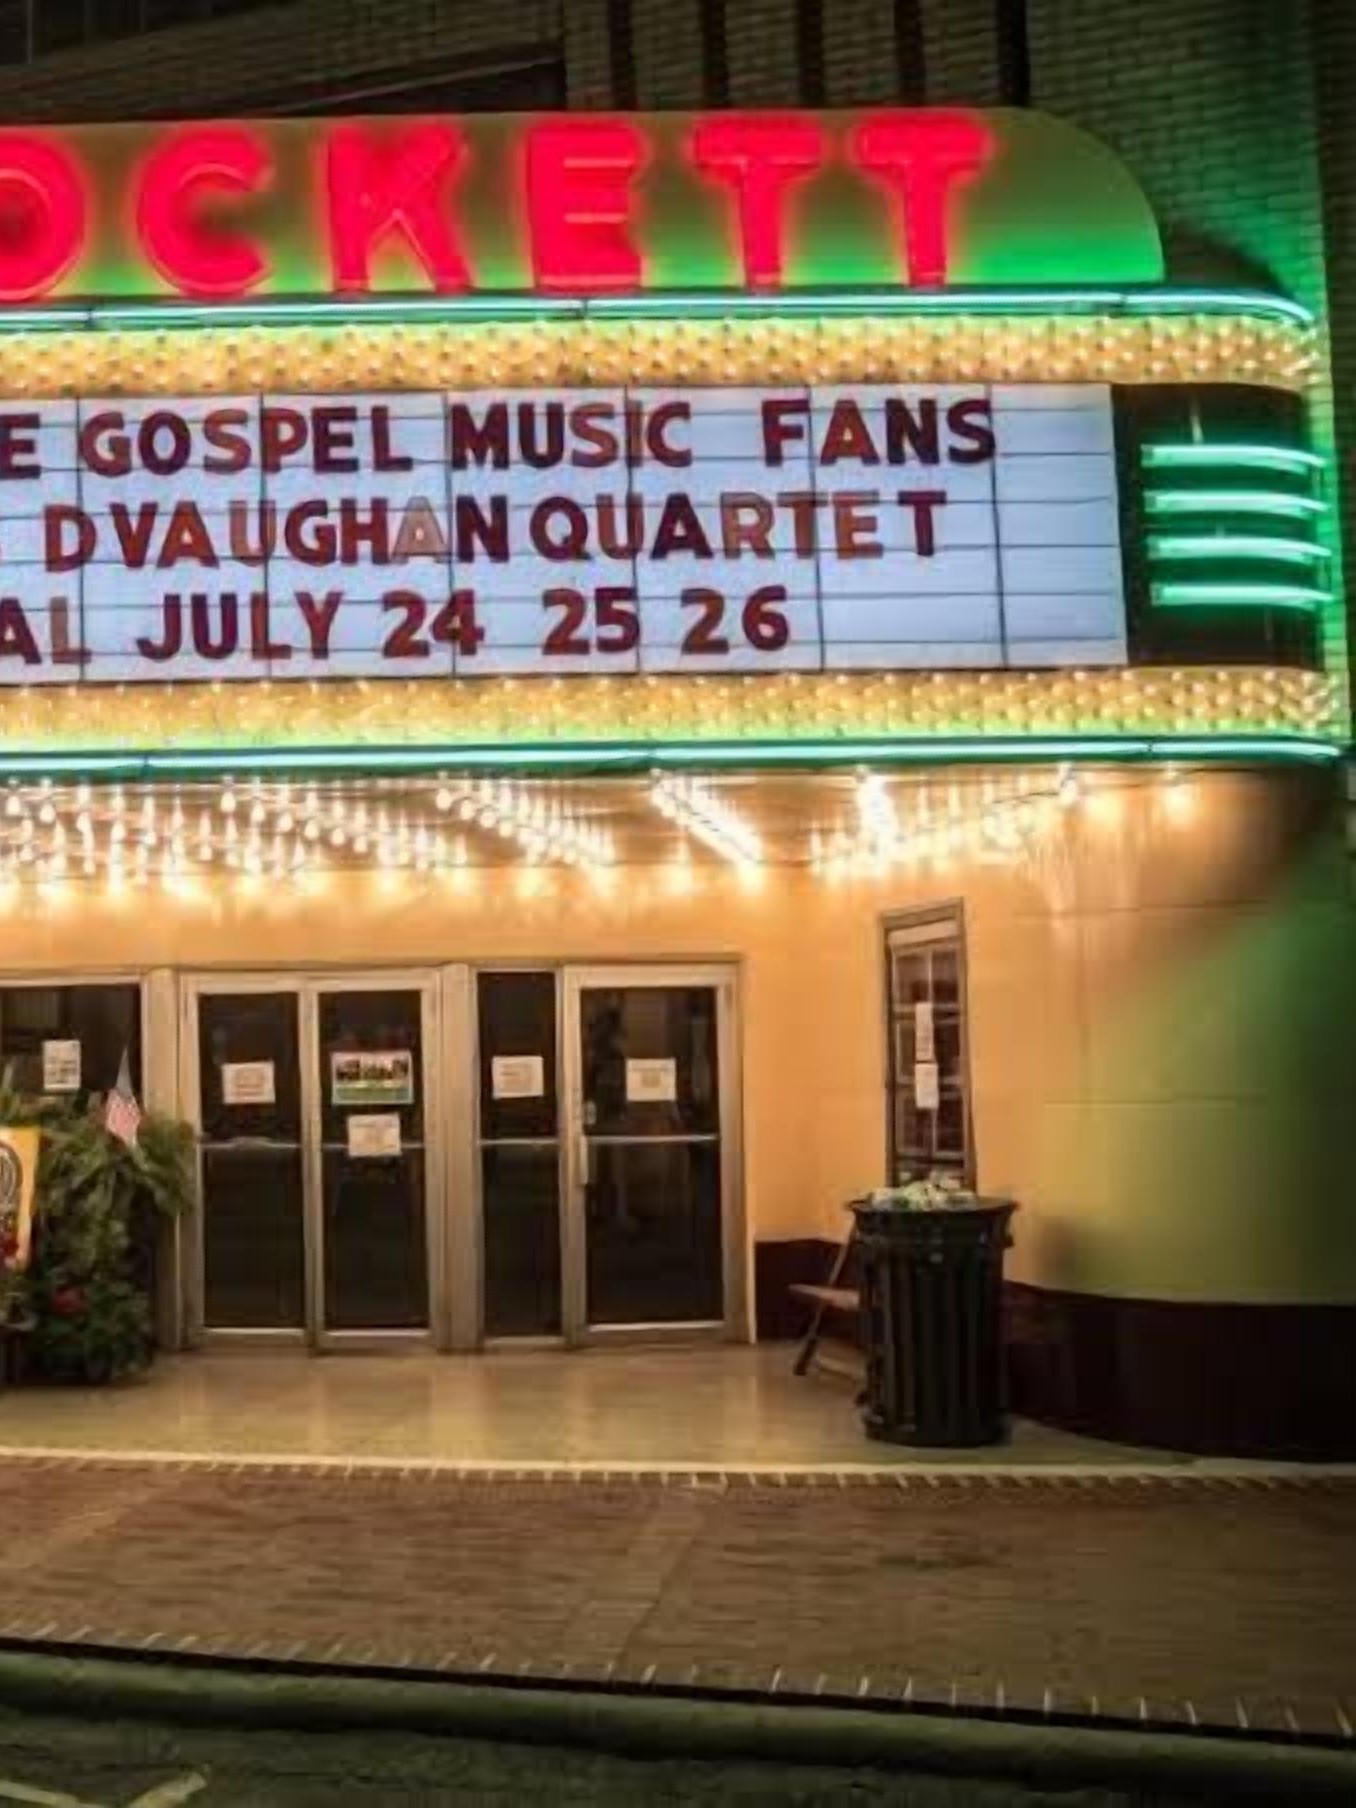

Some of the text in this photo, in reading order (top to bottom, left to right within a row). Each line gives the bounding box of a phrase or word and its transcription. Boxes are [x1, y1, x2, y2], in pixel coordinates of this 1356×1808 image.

[78, 404, 414, 479] GOSPEL
[449, 399, 693, 471] MUSIC
[760, 397, 997, 467] FANS
[529, 490, 947, 562] QUARTET
[135, 590, 342, 662] JULY
[381, 588, 485, 658] 24
[541, 587, 641, 656] 25
[680, 586, 789, 655] 26
